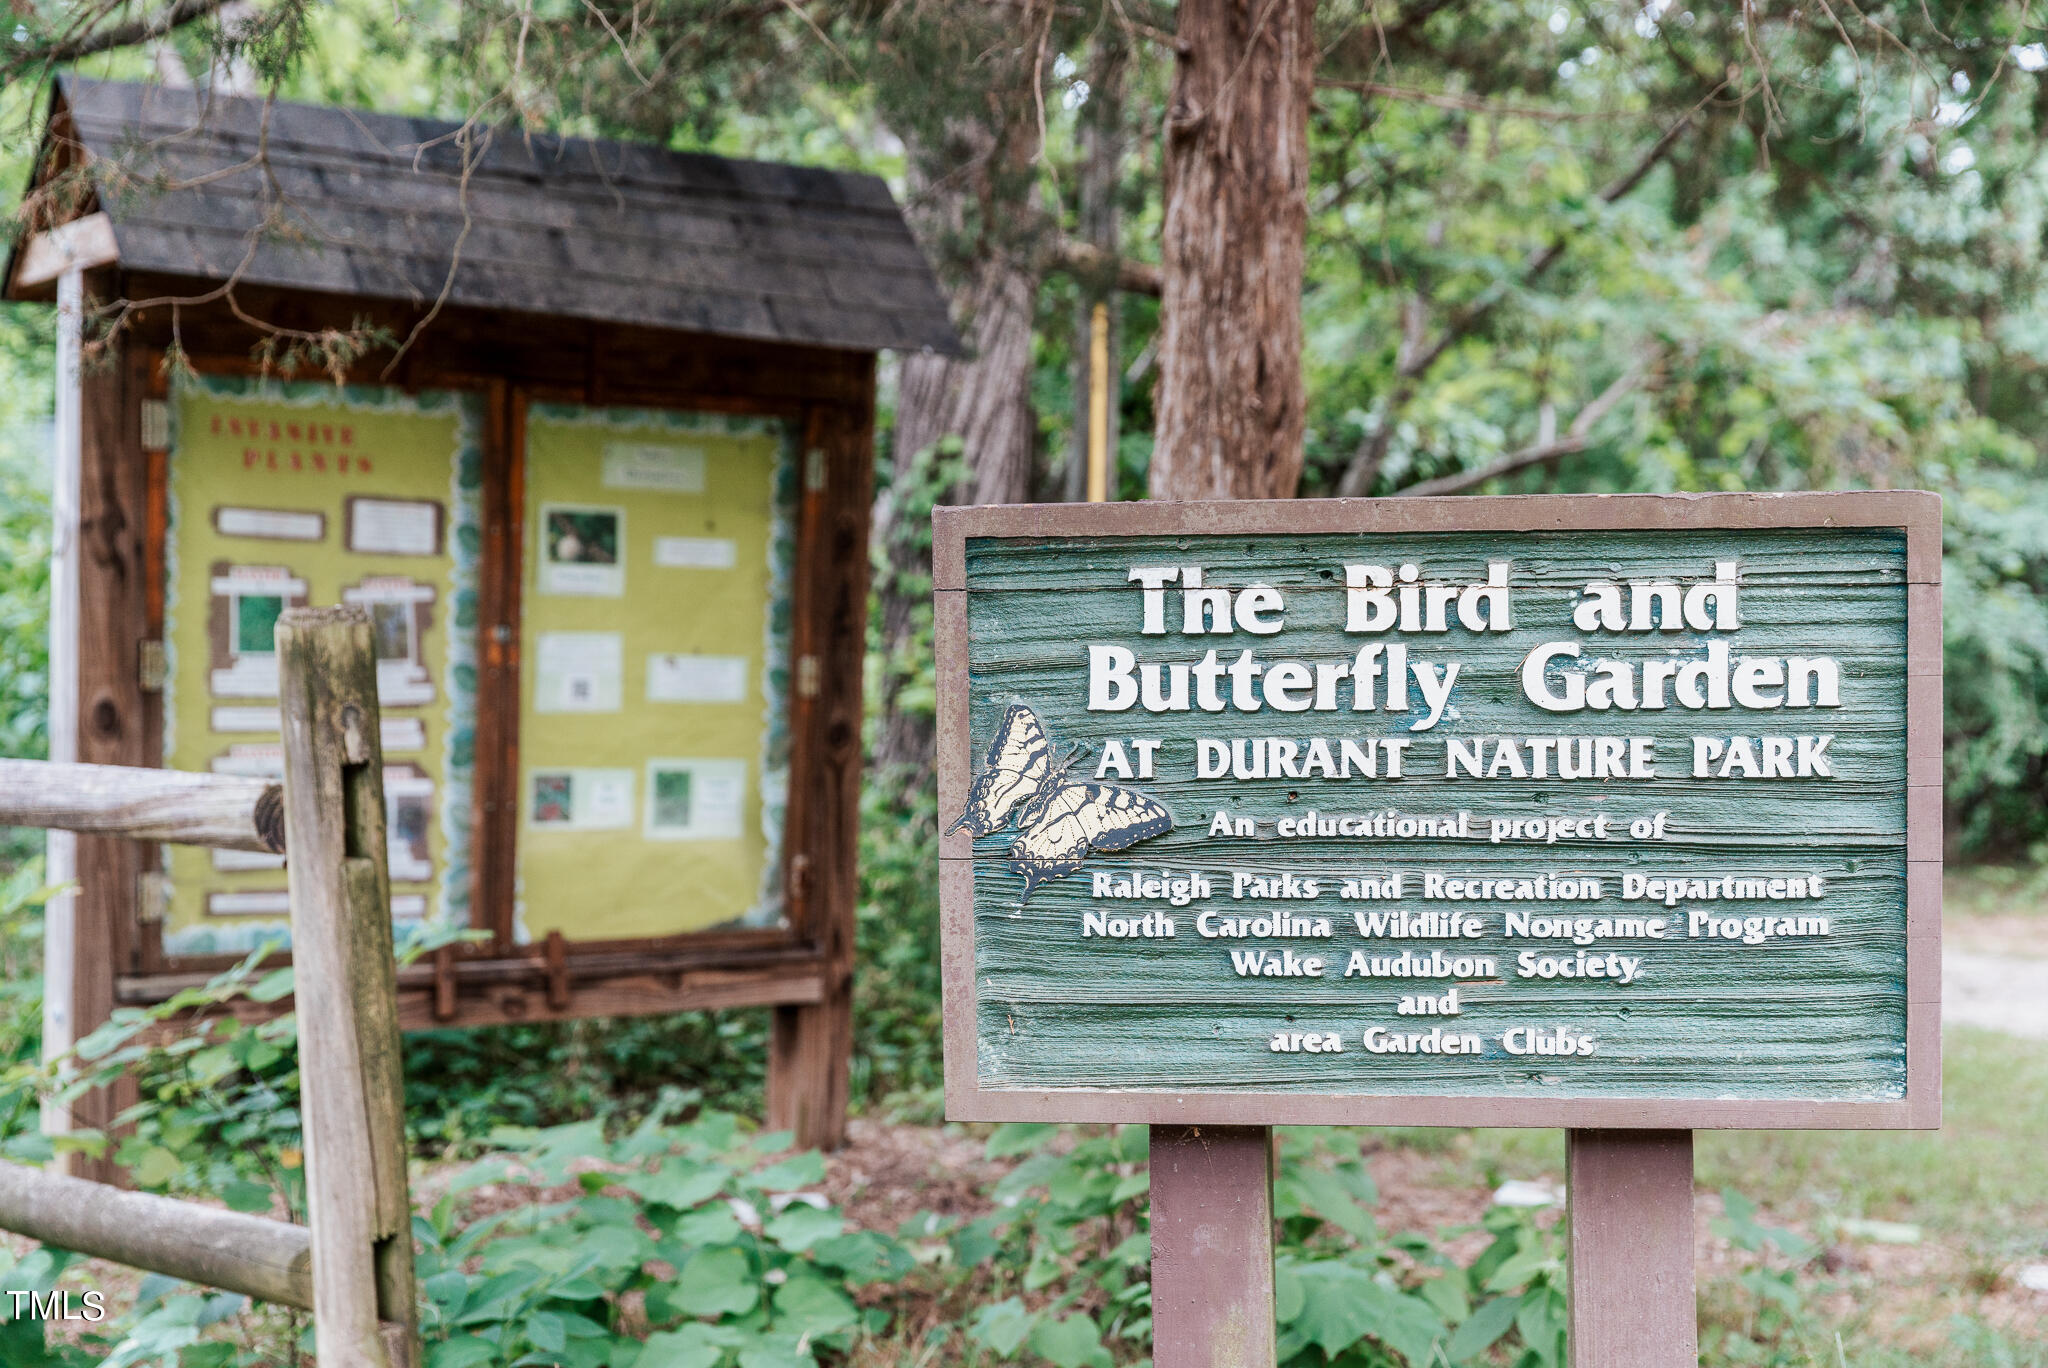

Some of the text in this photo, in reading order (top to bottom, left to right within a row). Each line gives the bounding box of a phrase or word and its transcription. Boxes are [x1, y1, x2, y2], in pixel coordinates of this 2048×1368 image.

[1128, 561, 1741, 635] The Bird and
[1087, 639, 1841, 731] Butterfly Garden
[1094, 735, 1835, 779] AT DURANT NATURE PARK
[1208, 811, 1667, 843] An educational project of
[1092, 871, 1824, 906] Raleigh Parks and Recreation Department
[1081, 911, 1829, 945] North Carolina Wildlife Nongame Program
[1230, 951, 1323, 977] Wake
[1344, 951, 1496, 978] Audubon
[1397, 989, 1460, 1016] and
[1269, 1026, 1596, 1056] area Garden Clubs
